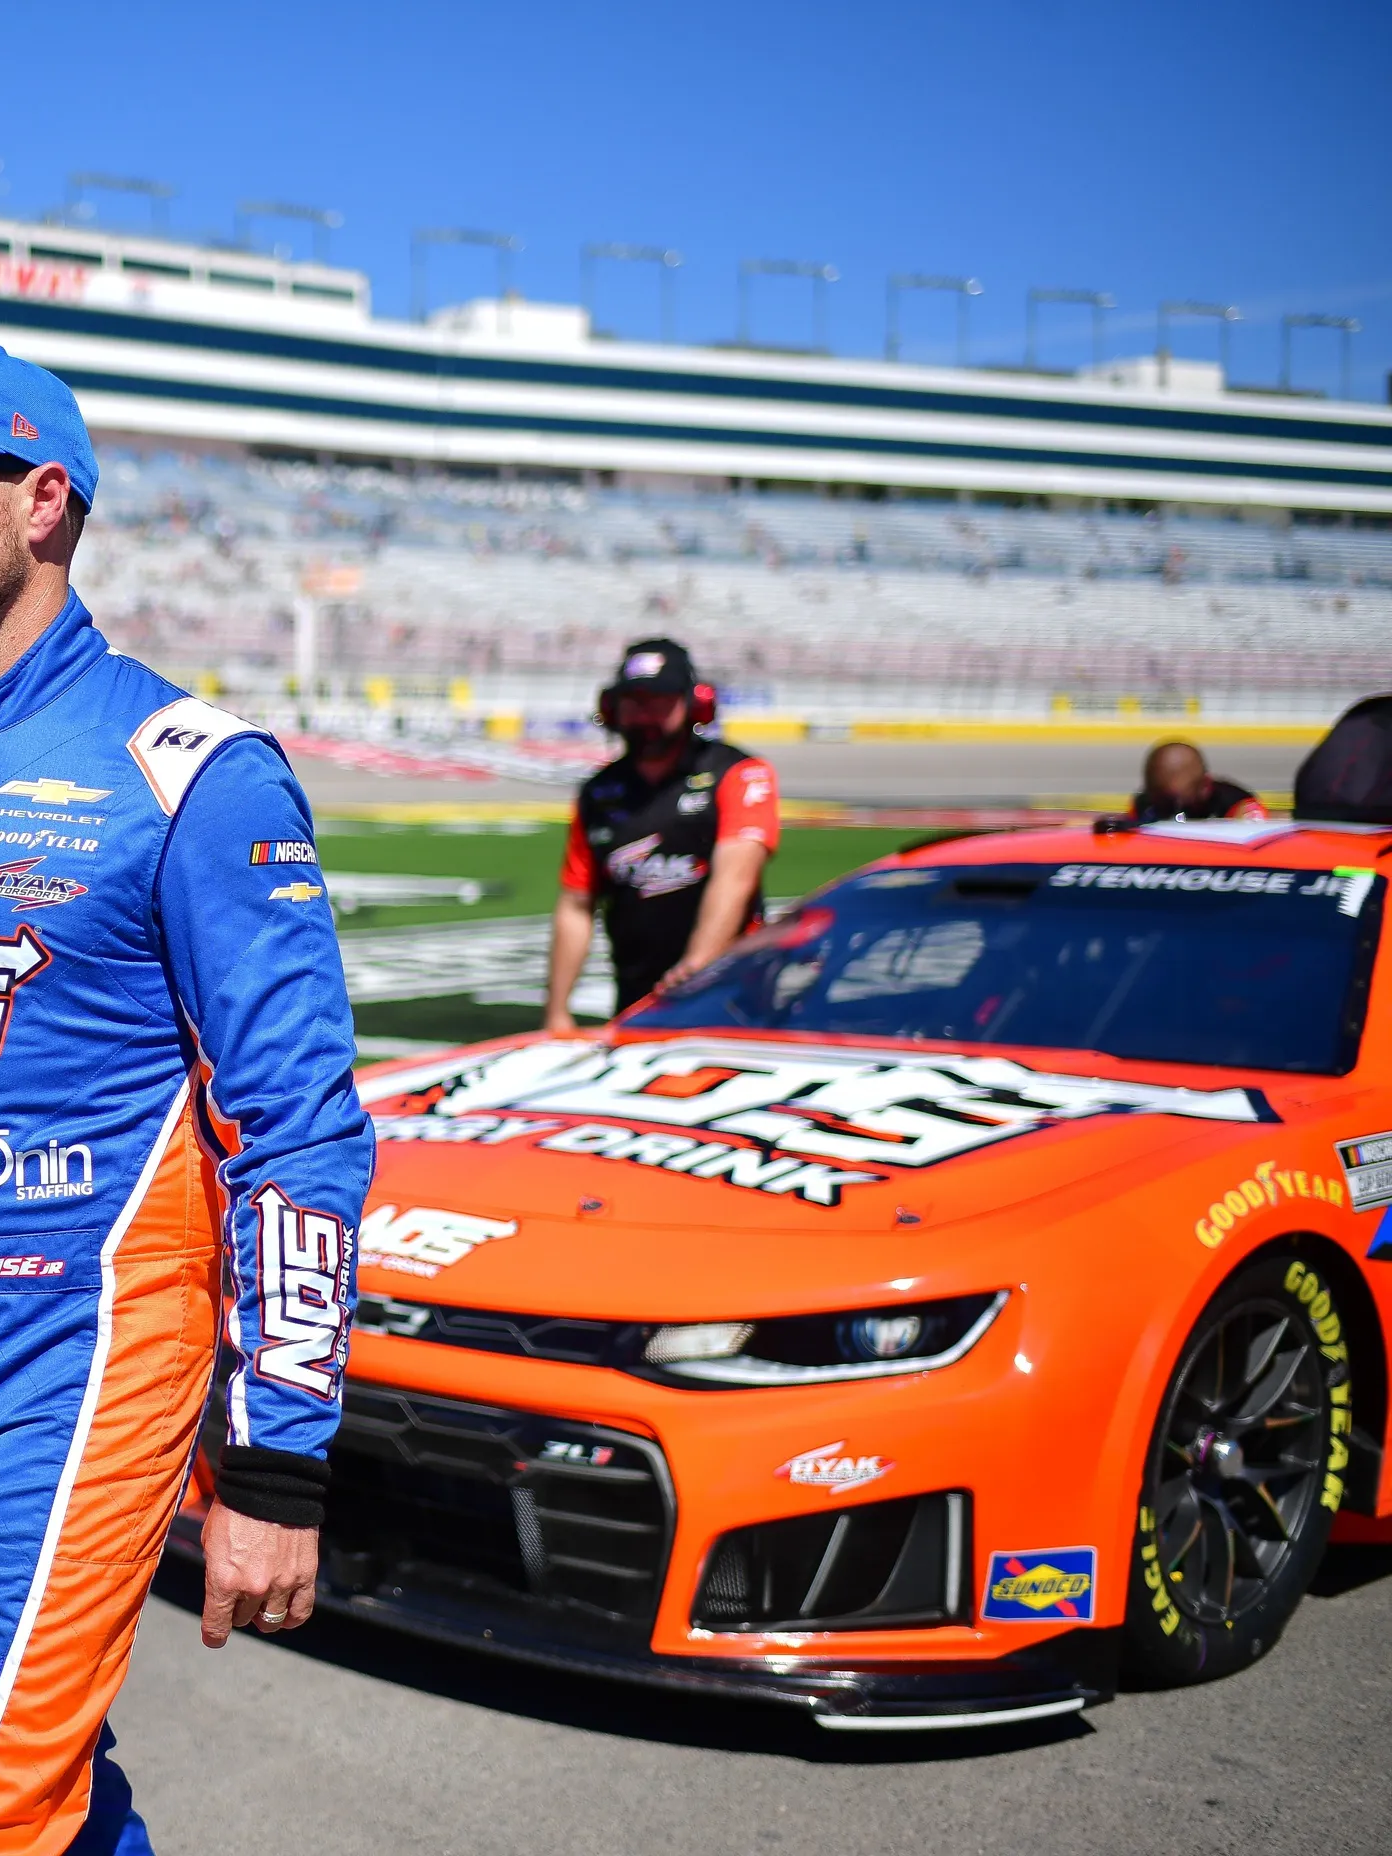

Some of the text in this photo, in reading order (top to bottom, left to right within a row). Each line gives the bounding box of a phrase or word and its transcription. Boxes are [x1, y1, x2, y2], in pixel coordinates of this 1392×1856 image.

[149, 726, 211, 751] K1
[274, 841, 317, 864] NASCA
[1049, 864, 1296, 894] STENHOUSE
[536, 1122, 886, 1206] DRINK
[16, 1182, 93, 1200] STAFFING
[41, 1260, 64, 1275] JR
[338, 1225, 355, 1304] DRINK
[252, 1183, 343, 1398] NOS
[1139, 1505, 1181, 1637] EAGLE
[999, 1576, 1088, 1597] SUNOCO
